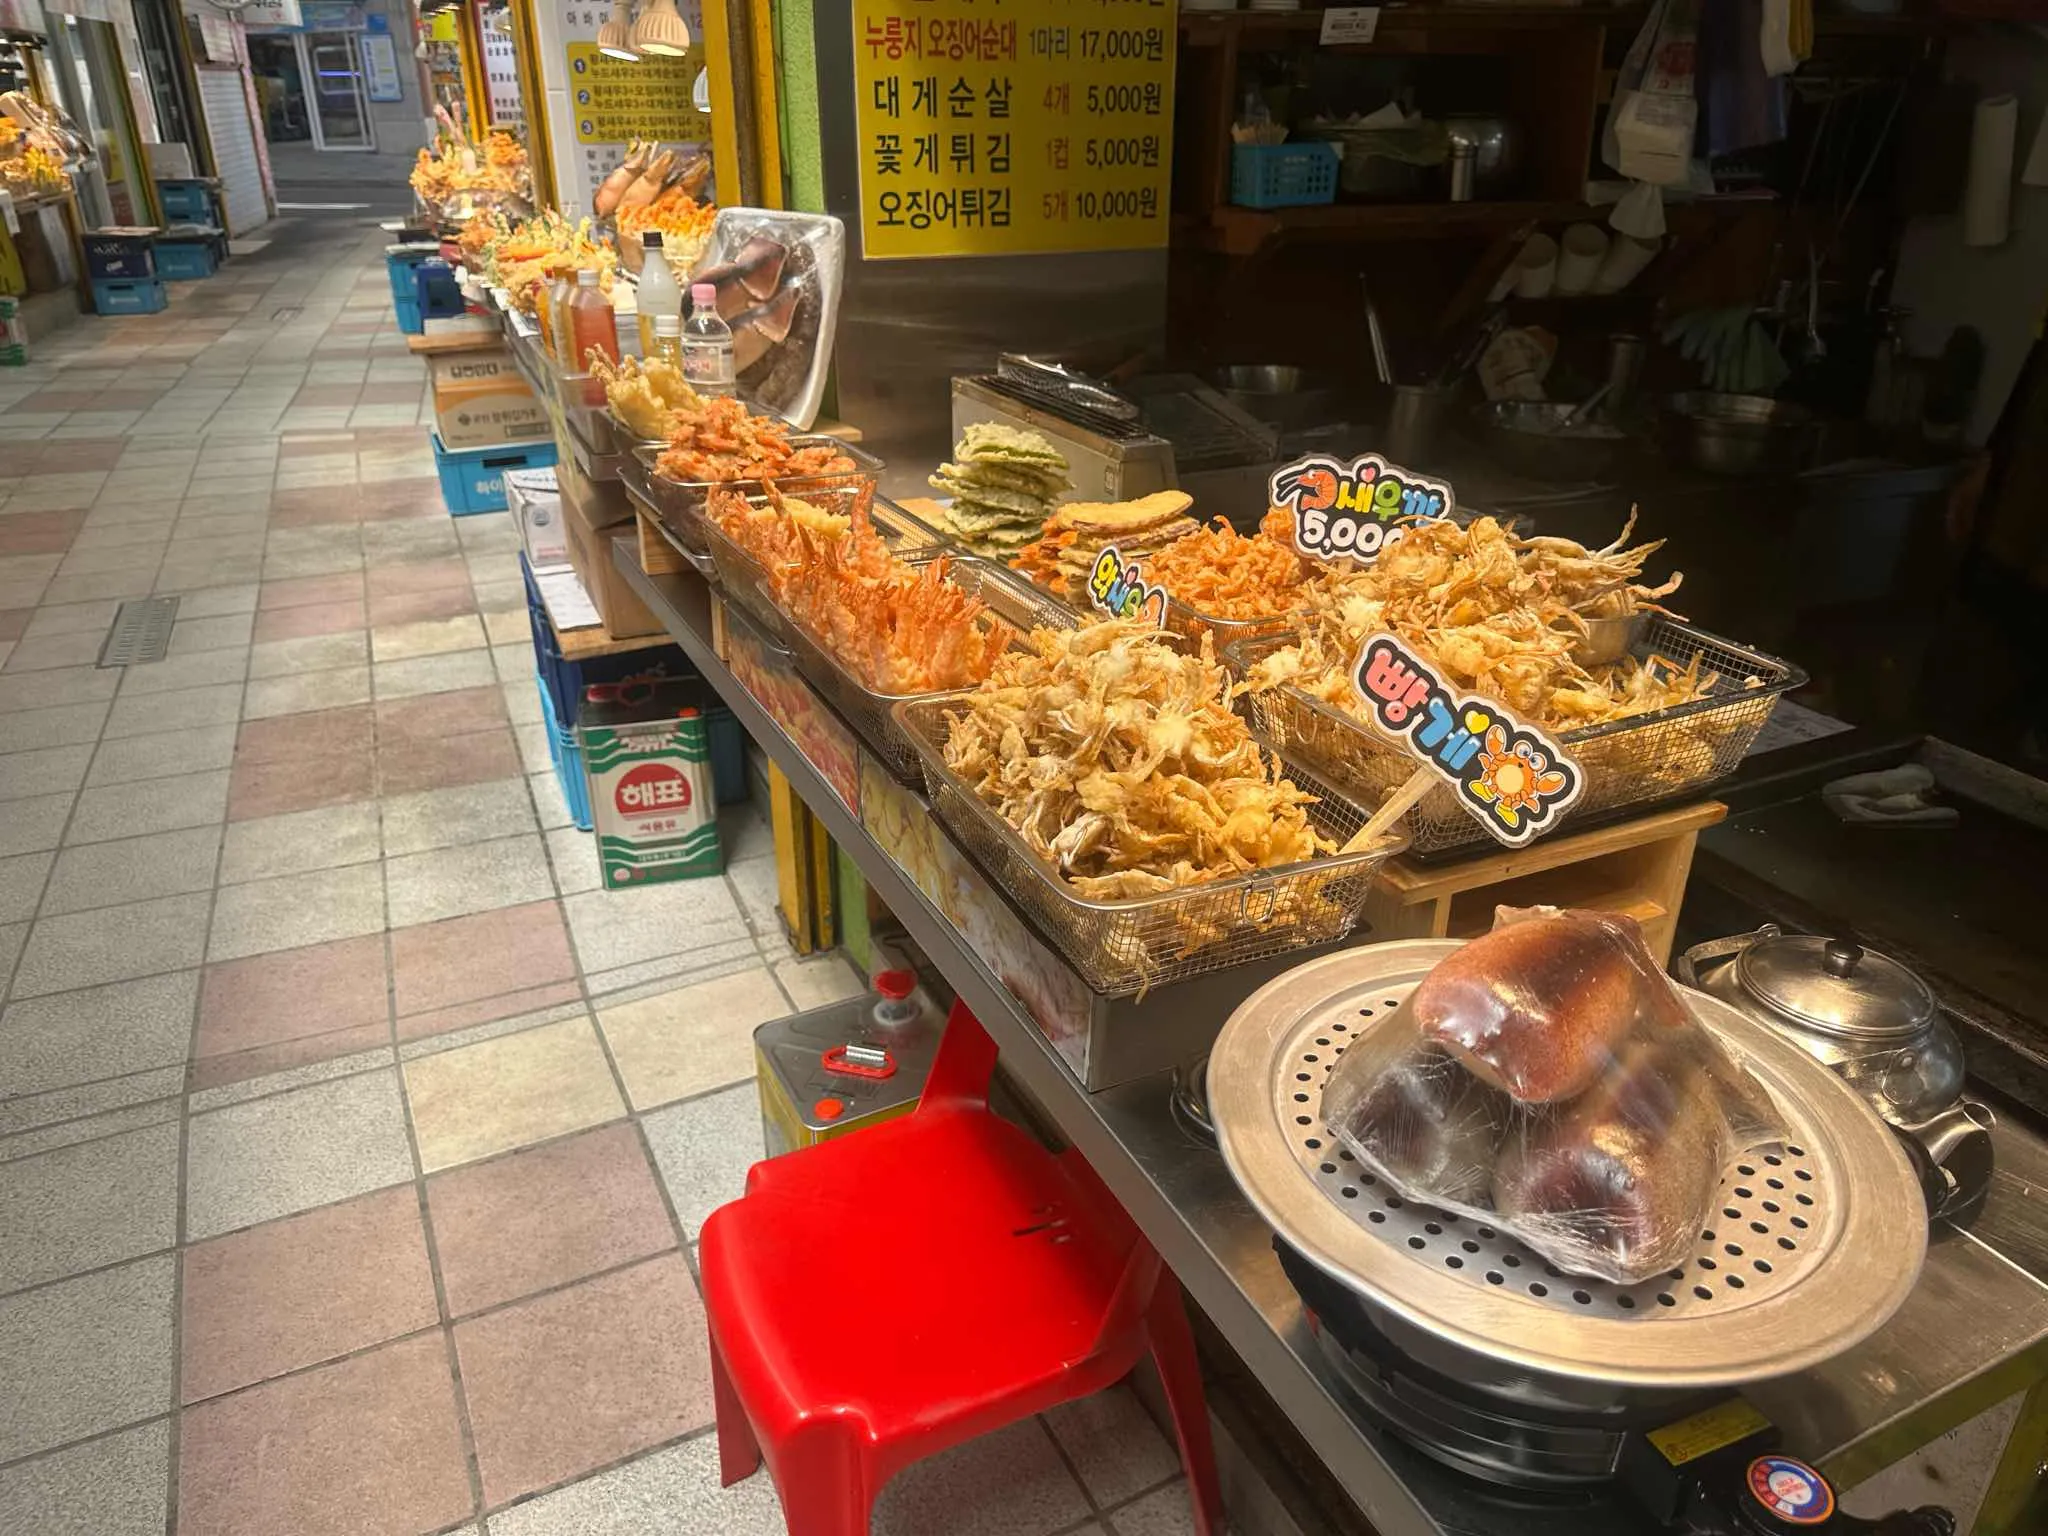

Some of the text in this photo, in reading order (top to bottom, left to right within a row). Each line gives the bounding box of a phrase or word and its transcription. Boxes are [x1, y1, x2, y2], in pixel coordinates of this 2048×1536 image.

[865, 16, 1163, 62] 누룽지 오징어순대 1마리 17,000원
[874, 76, 1161, 118] 대게순살 4개 5,000원
[874, 133, 1159, 175] 꽃게튀김 1컵 5,000원
[876, 188, 1158, 229] 오징어튀김 5개 10,000원
[1365, 648, 1481, 771] 빵게
[620, 779, 685, 807] 해표
